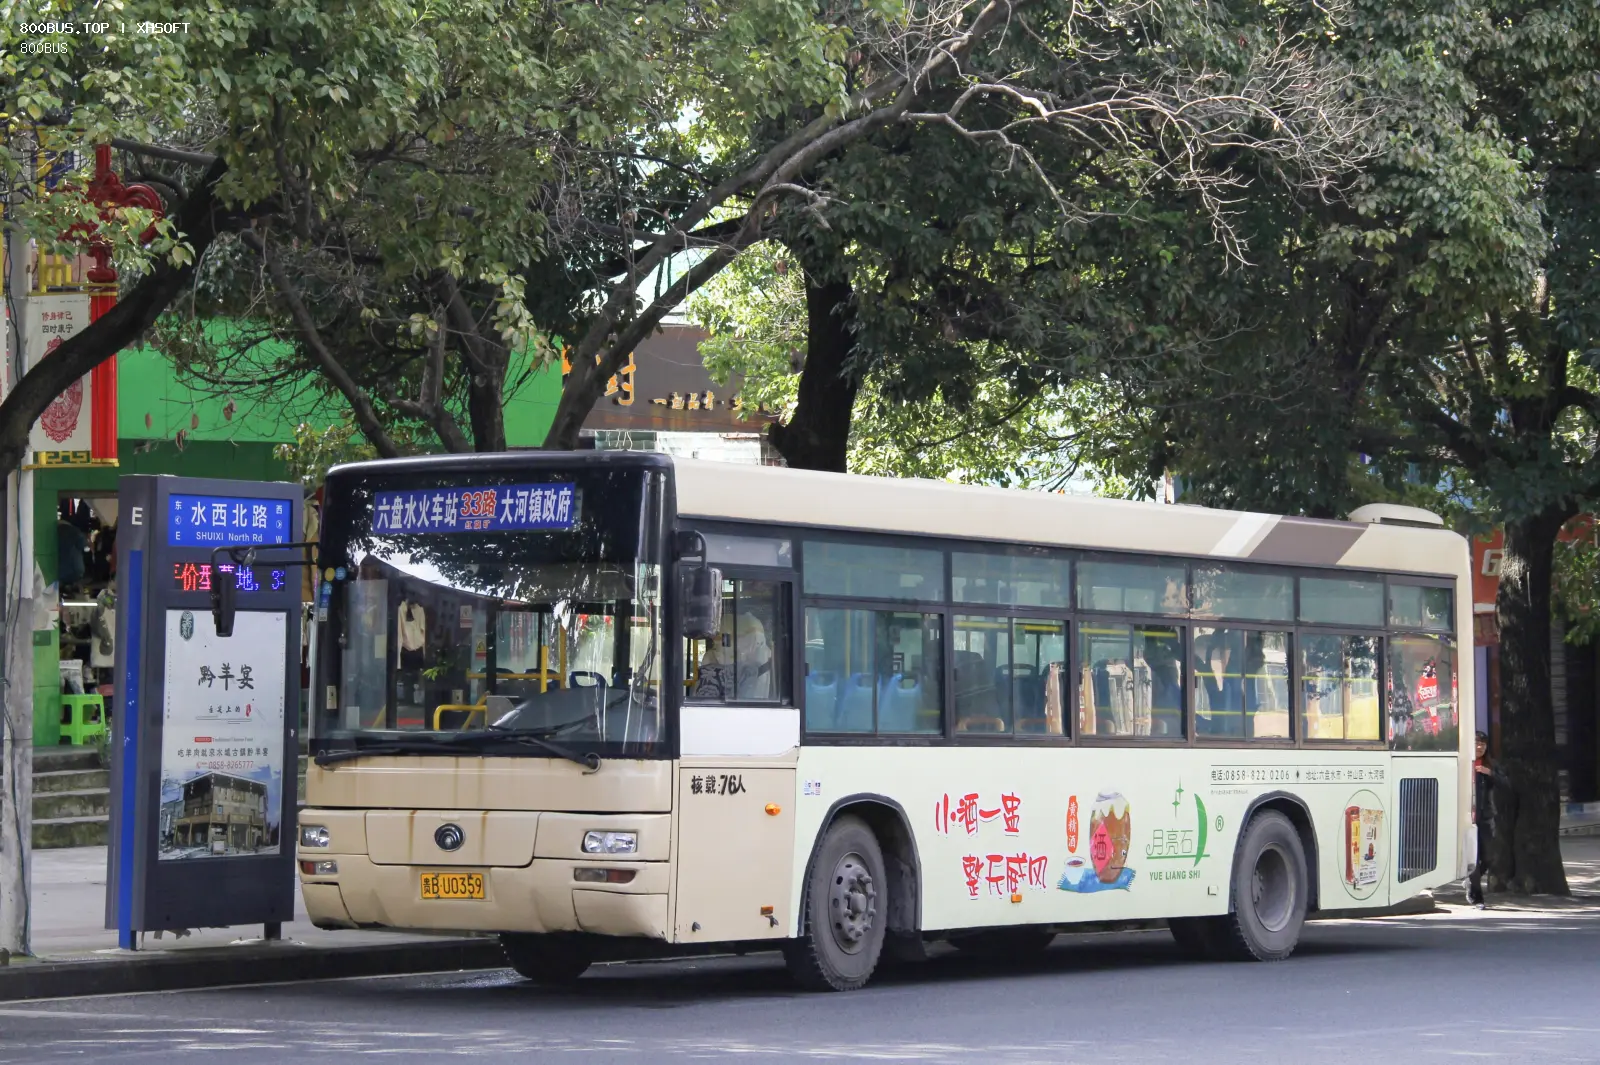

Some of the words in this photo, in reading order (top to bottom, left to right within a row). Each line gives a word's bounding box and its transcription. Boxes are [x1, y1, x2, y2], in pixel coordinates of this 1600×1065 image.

[174, 500, 182, 510] 东
[275, 504, 283, 515] 西
[376, 492, 459, 530] 六盘水火车站
[460, 489, 497, 517] 33路
[500, 487, 572, 524] 大河镇政府
[131, 506, 144, 526] E
[190, 501, 268, 529] 水西北路
[175, 531, 181, 541] E
[196, 531, 224, 541] SHUIXI
[228, 532, 250, 542] North
[252, 534, 263, 543] Rd
[198, 663, 255, 691] 黔羊宴
[1270, 769, 1290, 780] 0206
[690, 774, 747, 796] 核载:76人
[1095, 834, 1107, 861] 酒
[1149, 871, 1163, 881] YUE
[1165, 870, 1187, 881] LIANG
[1188, 869, 1201, 880] SHI
